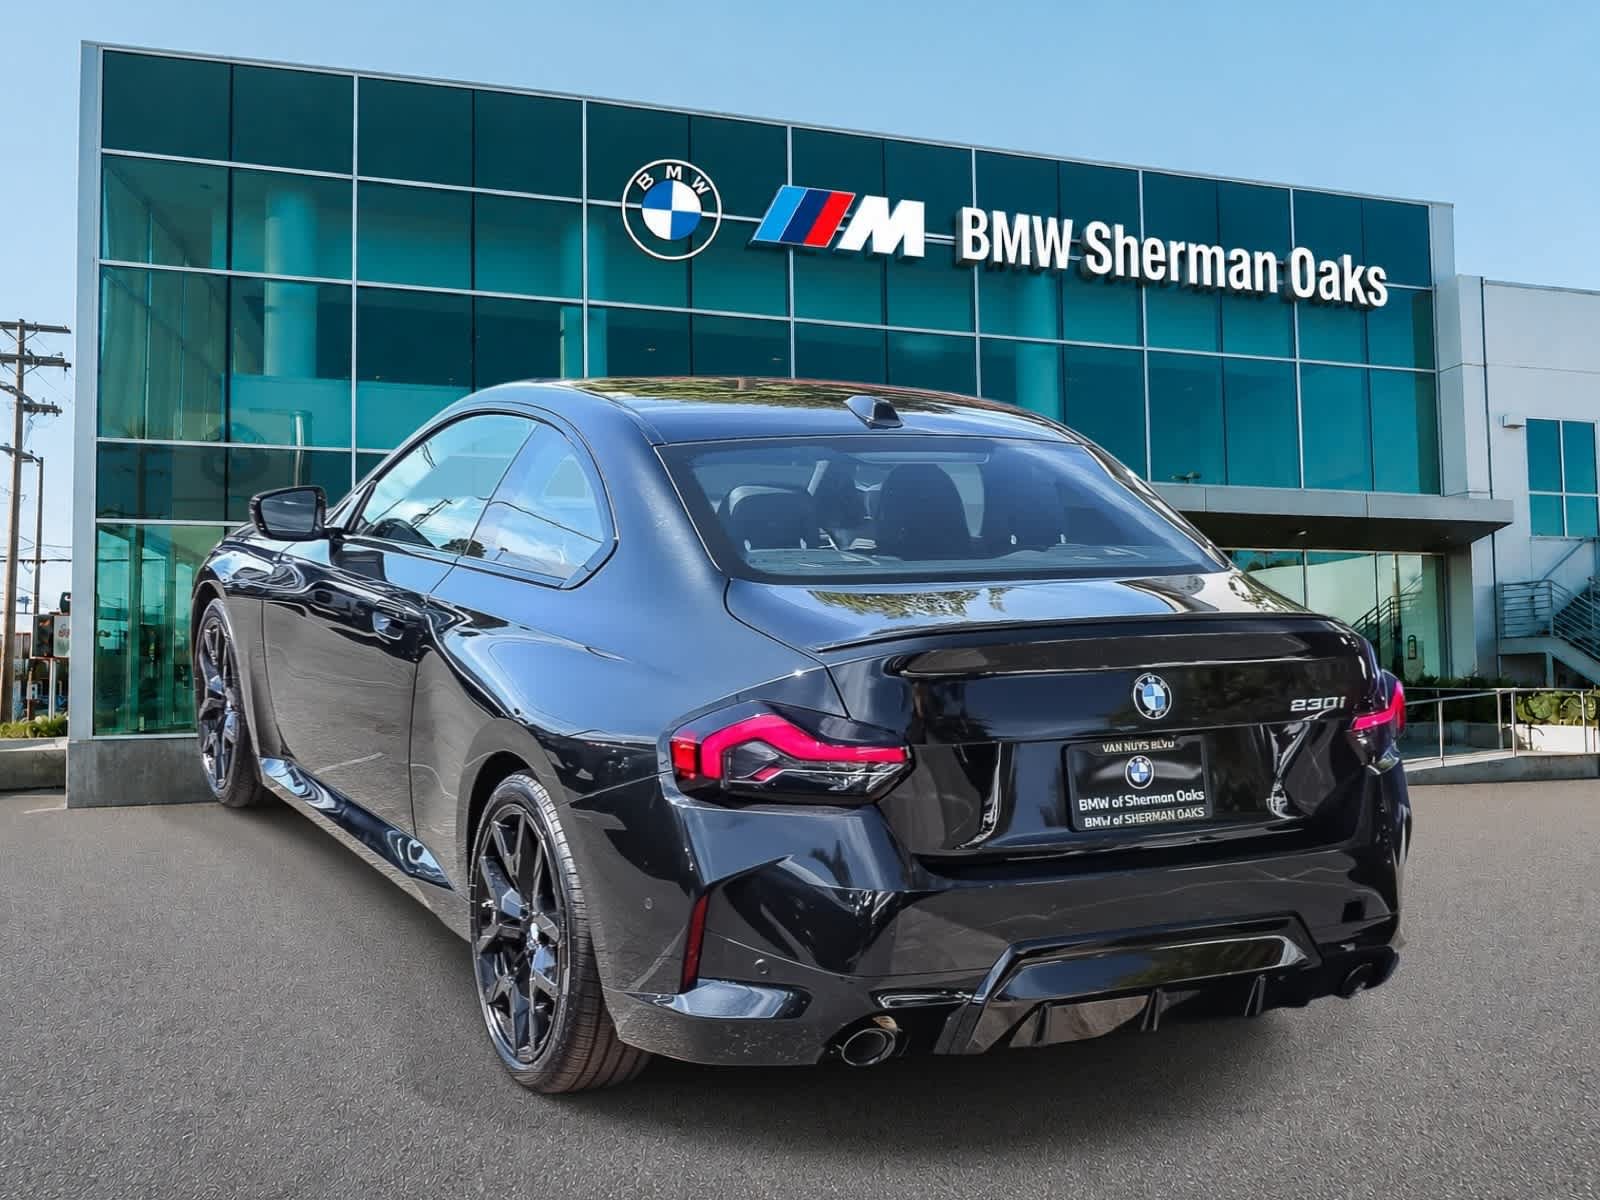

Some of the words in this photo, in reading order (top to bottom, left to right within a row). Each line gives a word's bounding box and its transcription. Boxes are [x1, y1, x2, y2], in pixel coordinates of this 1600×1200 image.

[636, 165, 711, 194] BMW
[836, 195, 925, 257] M
[960, 206, 1073, 269] BMW
[1083, 221, 1279, 294] Sherman
[1288, 247, 1388, 307] Oaks
[1290, 696, 1346, 711] 230i
[1103, 743, 1122, 752] VAN
[1124, 741, 1149, 751] NUYS
[1079, 797, 1109, 811] BMW
[1112, 796, 1124, 808] of
[1125, 792, 1175, 806] Sherman
[1176, 789, 1205, 802] Oaks
[1084, 816, 1111, 828] BMW
[1113, 815, 1124, 825] of
[1125, 810, 1175, 824] SHERMAN
[1177, 807, 1205, 819] OAKS
